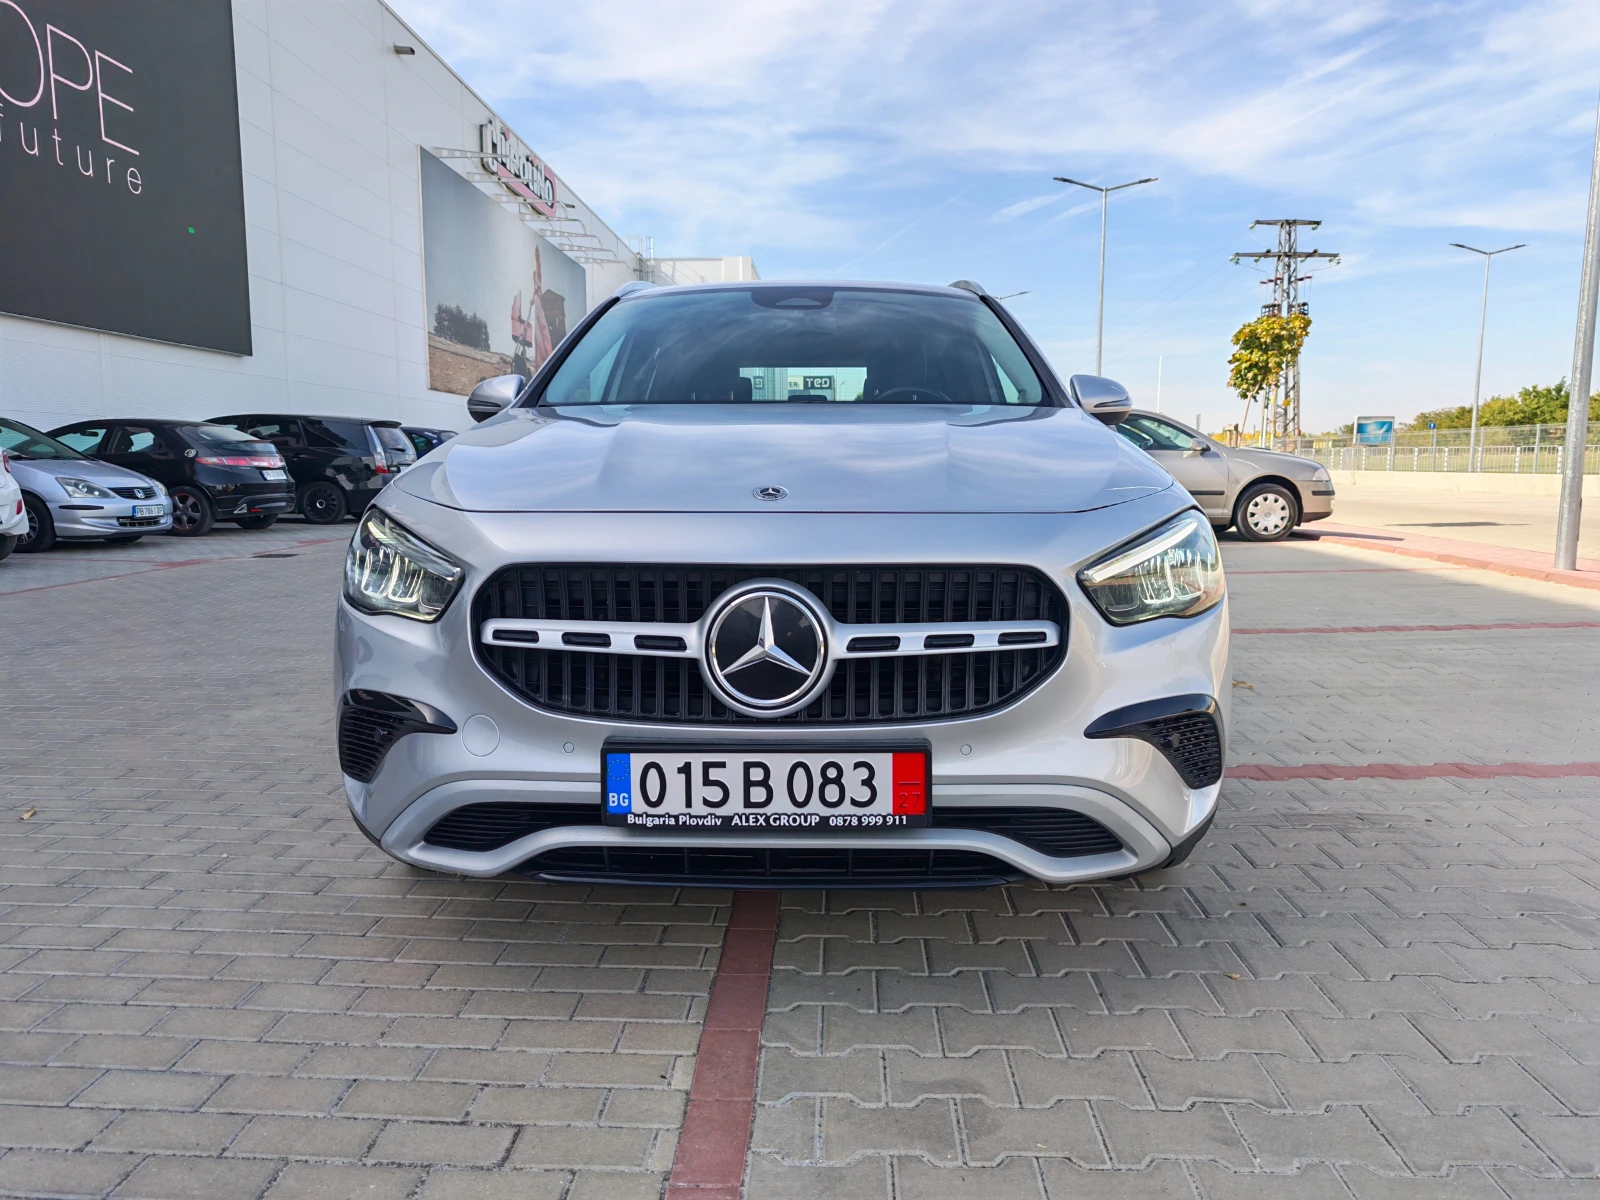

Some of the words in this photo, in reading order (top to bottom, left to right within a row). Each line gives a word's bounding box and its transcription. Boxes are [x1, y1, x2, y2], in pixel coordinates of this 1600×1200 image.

[640, 761, 730, 808] 015
[743, 761, 774, 808] B
[787, 760, 877, 808] 083
[608, 793, 629, 806] BG
[899, 791, 921, 808] 27
[627, 813, 676, 828] Bulgaria
[679, 814, 722, 826] Plovdiv
[731, 814, 766, 826] ALEX
[769, 814, 820, 827] GROUP
[829, 815, 858, 826] 0878
[861, 815, 883, 826] 999
[886, 814, 907, 825] 911
